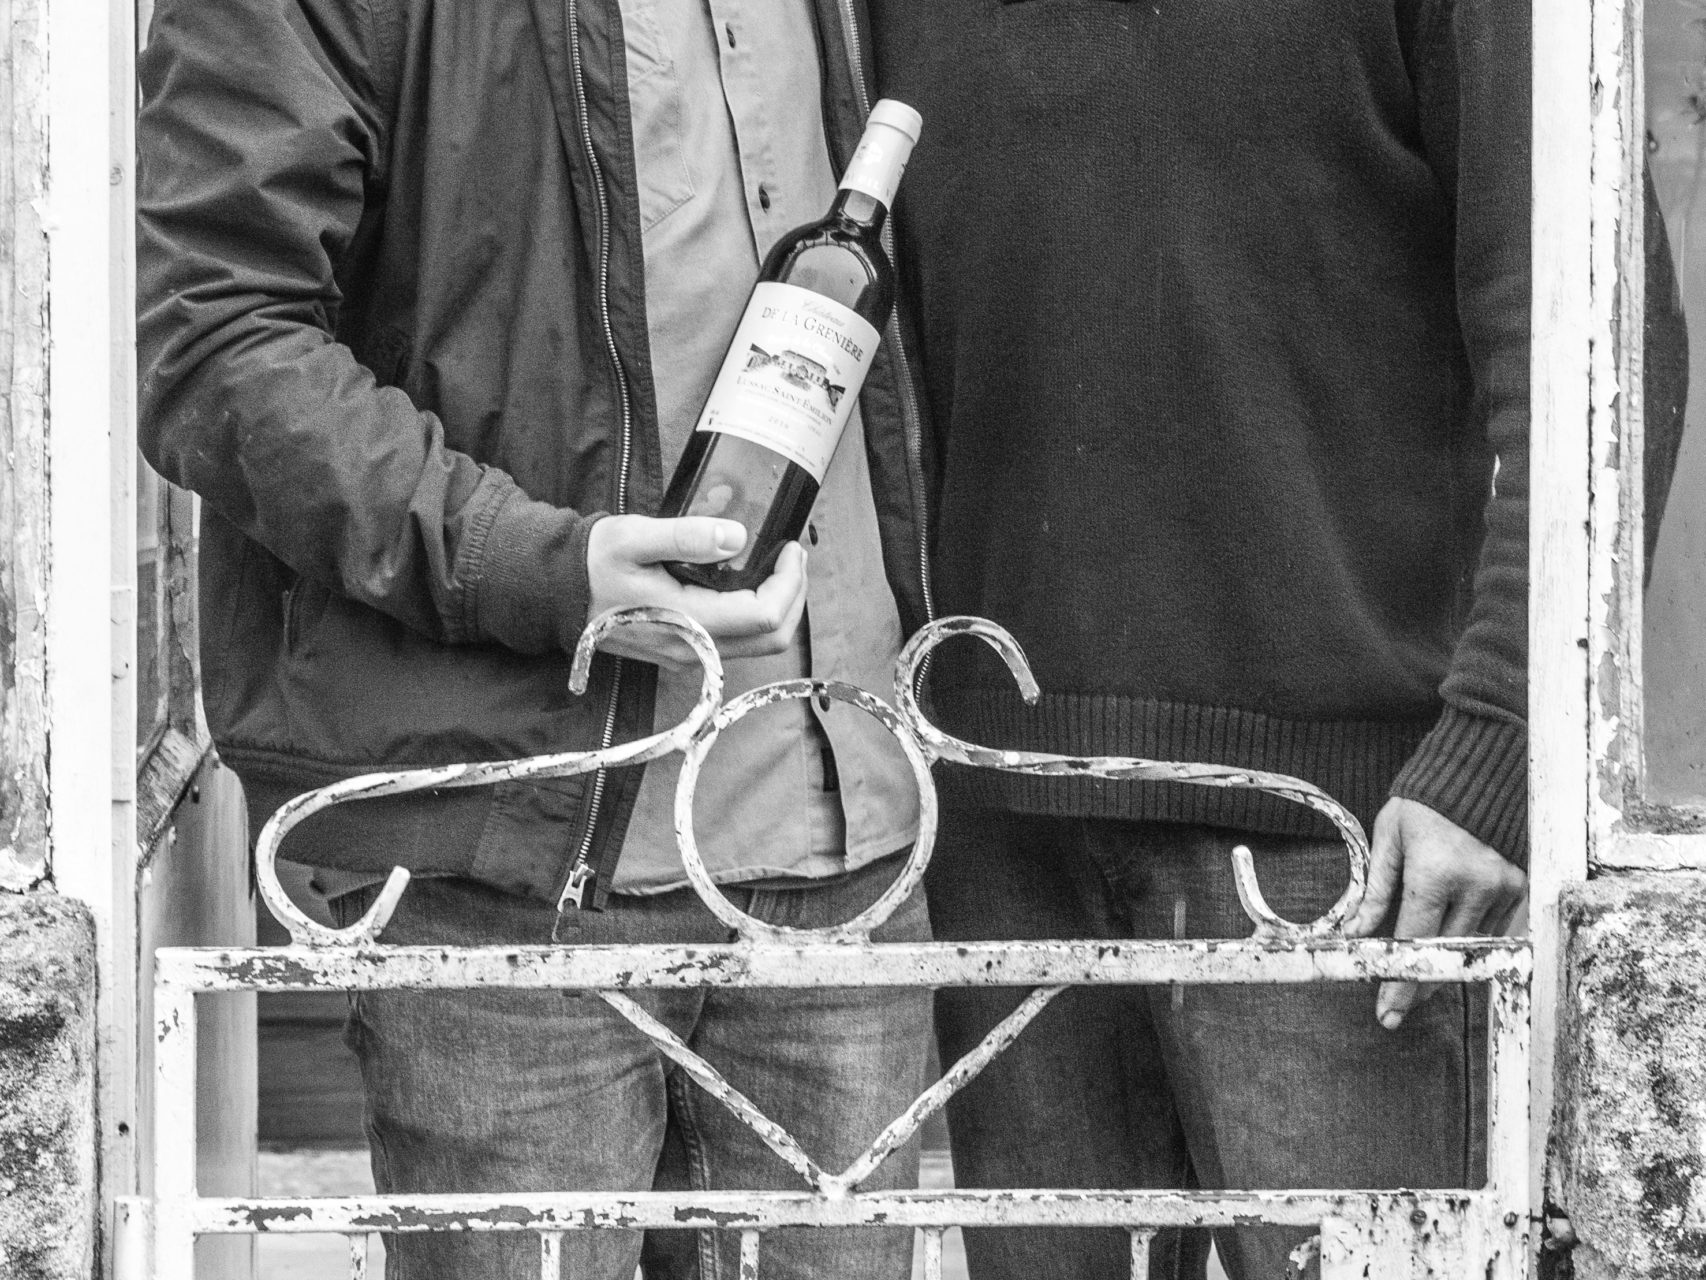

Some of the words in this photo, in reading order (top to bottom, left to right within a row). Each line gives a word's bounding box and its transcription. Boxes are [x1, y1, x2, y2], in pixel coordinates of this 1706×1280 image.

[761, 306, 780, 320] DE
[781, 310, 799, 328] LA
[803, 316, 865, 362] GRENIÈRE
